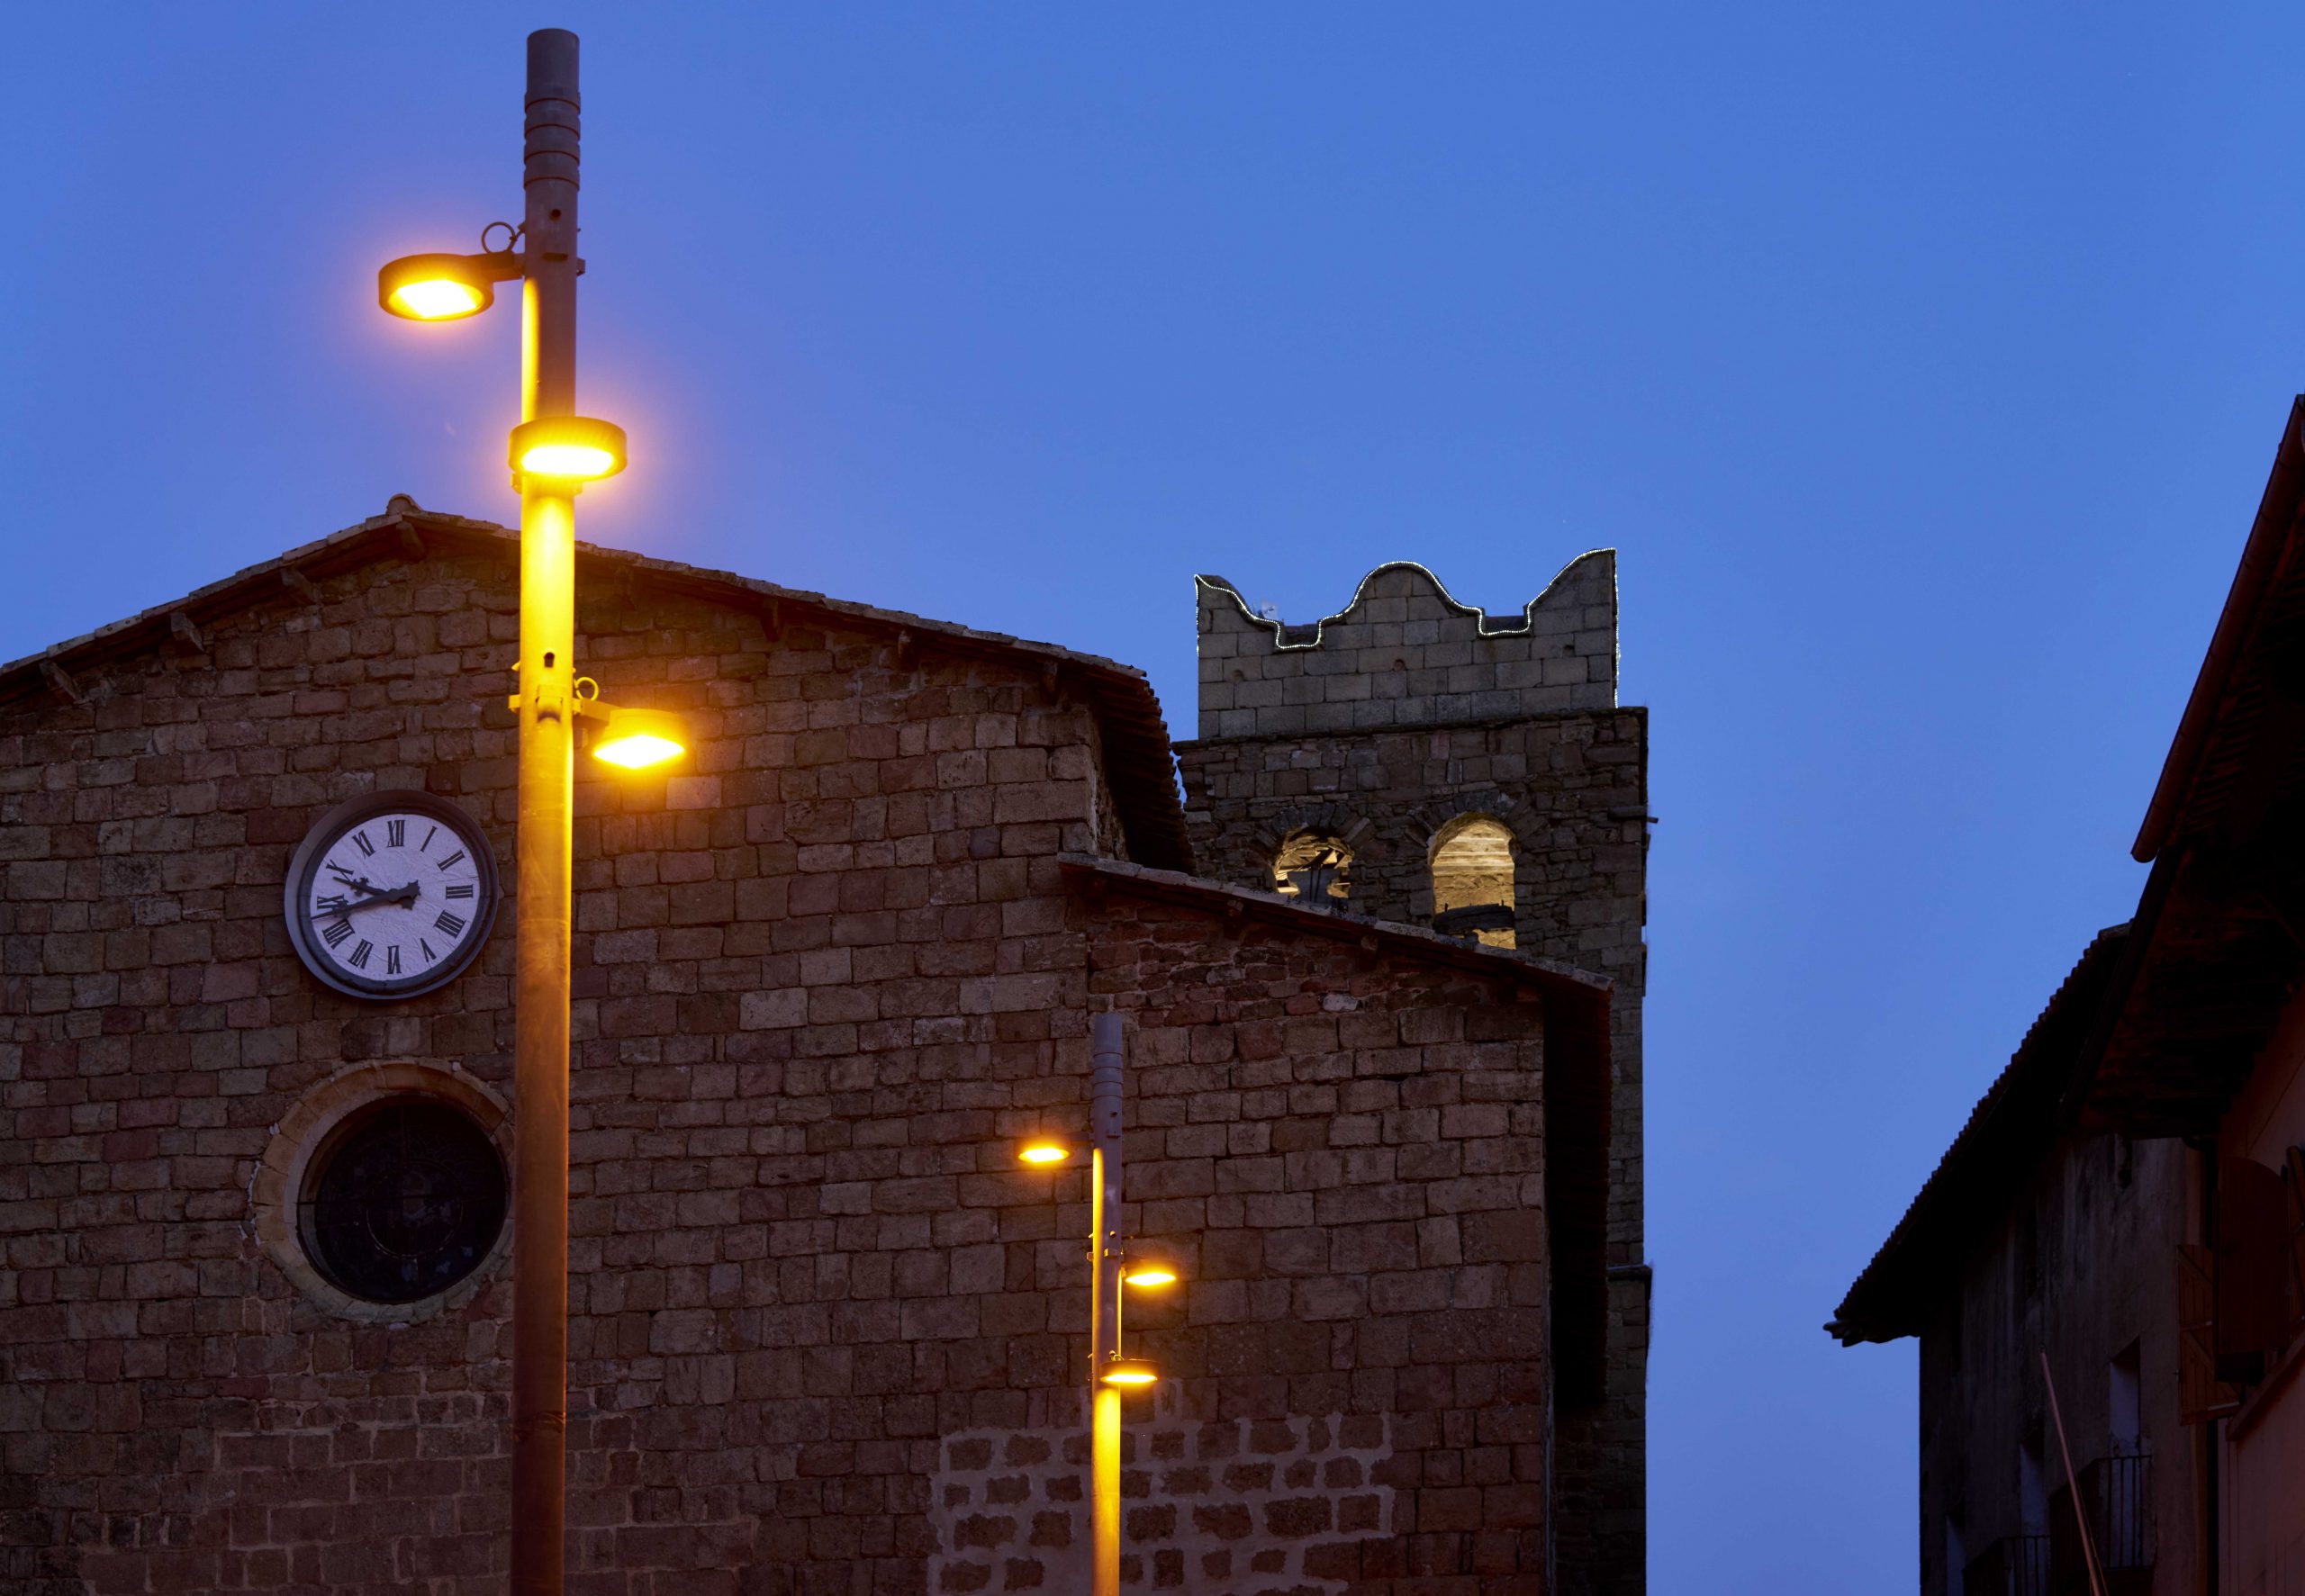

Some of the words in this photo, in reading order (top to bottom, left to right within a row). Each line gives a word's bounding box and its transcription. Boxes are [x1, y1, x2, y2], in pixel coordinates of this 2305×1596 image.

[352, 830, 376, 859] XI
[387, 820, 405, 847] XII
[420, 826, 438, 852] I
[326, 859, 354, 882] X
[438, 850, 466, 871] II
[445, 885, 474, 900] III
[322, 918, 356, 950] VIII
[433, 910, 466, 939] IIII
[348, 939, 374, 969] VII
[387, 945, 402, 974] VI
[420, 938, 437, 963] V
